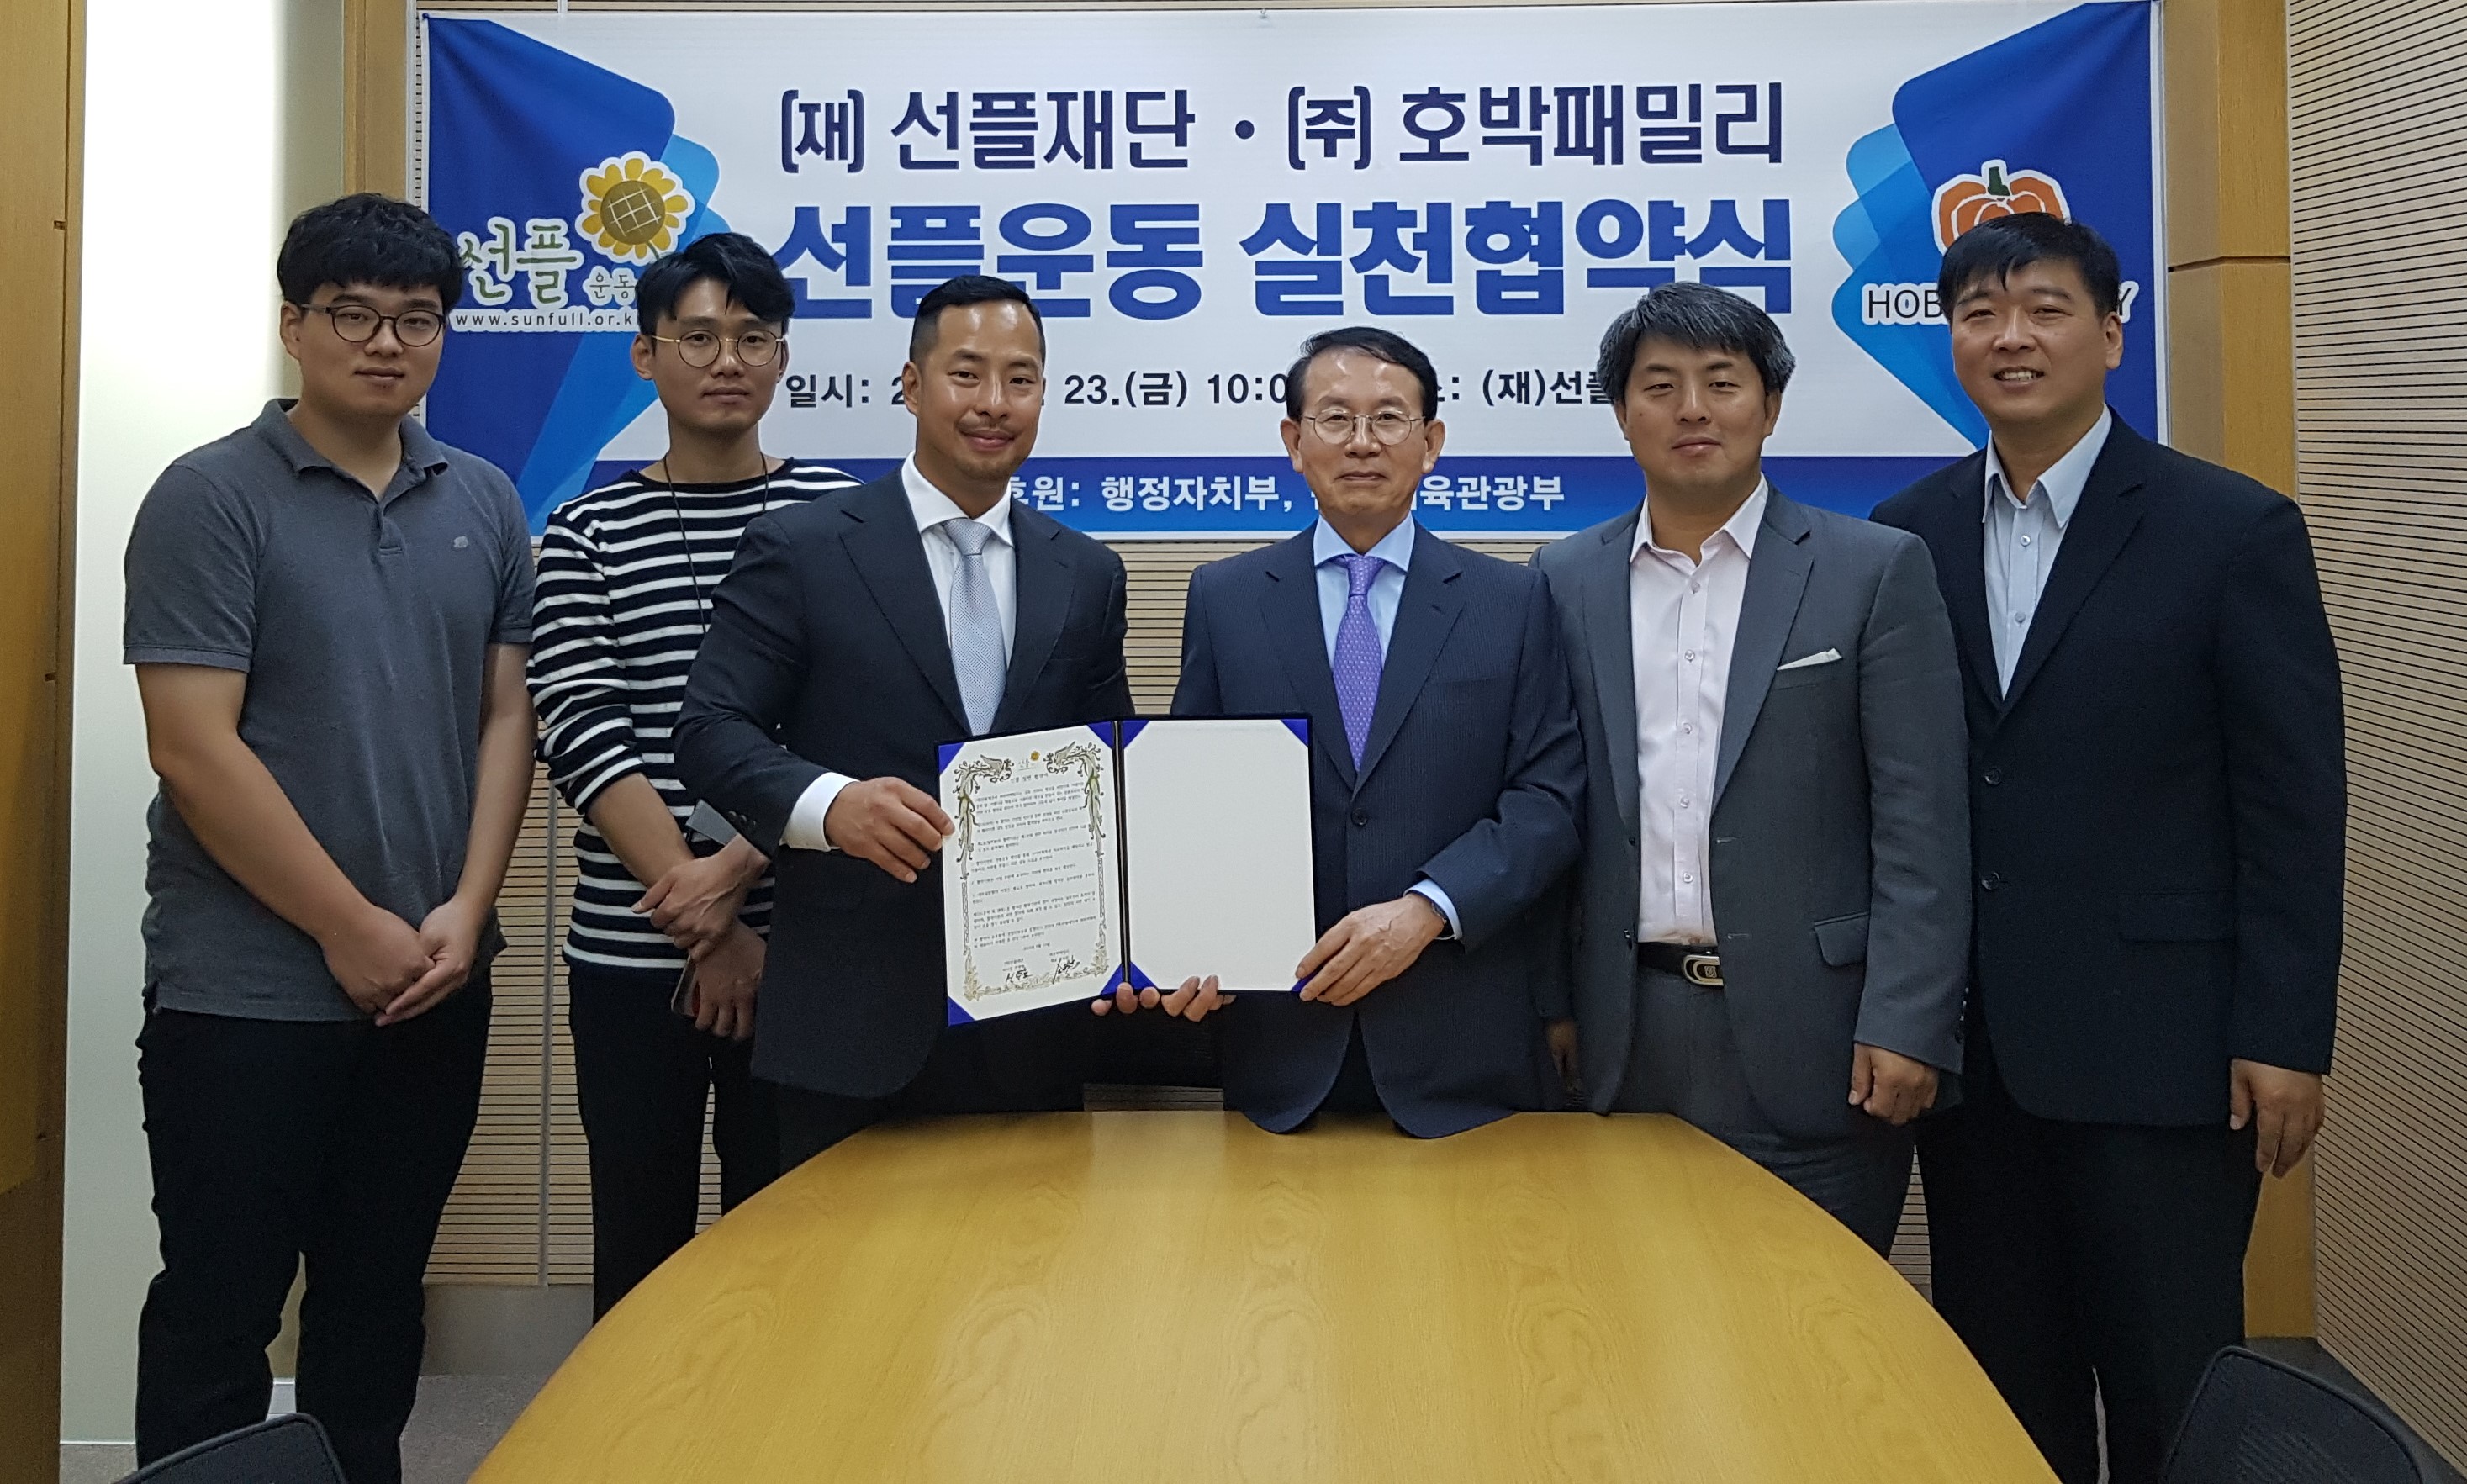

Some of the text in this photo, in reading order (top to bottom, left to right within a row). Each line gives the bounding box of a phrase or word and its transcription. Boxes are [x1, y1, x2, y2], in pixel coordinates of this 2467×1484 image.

[890, 89, 1197, 171] 선플재단
[1399, 82, 1783, 167] 호박패밀리
[462, 223, 635, 304] 선플 운동
[769, 198, 1793, 320] 선플운동 실천협약식
[456, 311, 639, 326] www.sunfull.or.k
[1867, 288, 1942, 319] HOB
[785, 372, 870, 409] 일시:
[1064, 370, 1188, 409] 23.(금)
[1208, 373, 1287, 404] 10:0
[1483, 369, 1614, 407] (재)선플
[1101, 475, 1293, 513] 행정자치부,
[1311, 475, 1565, 511] 육관광부
